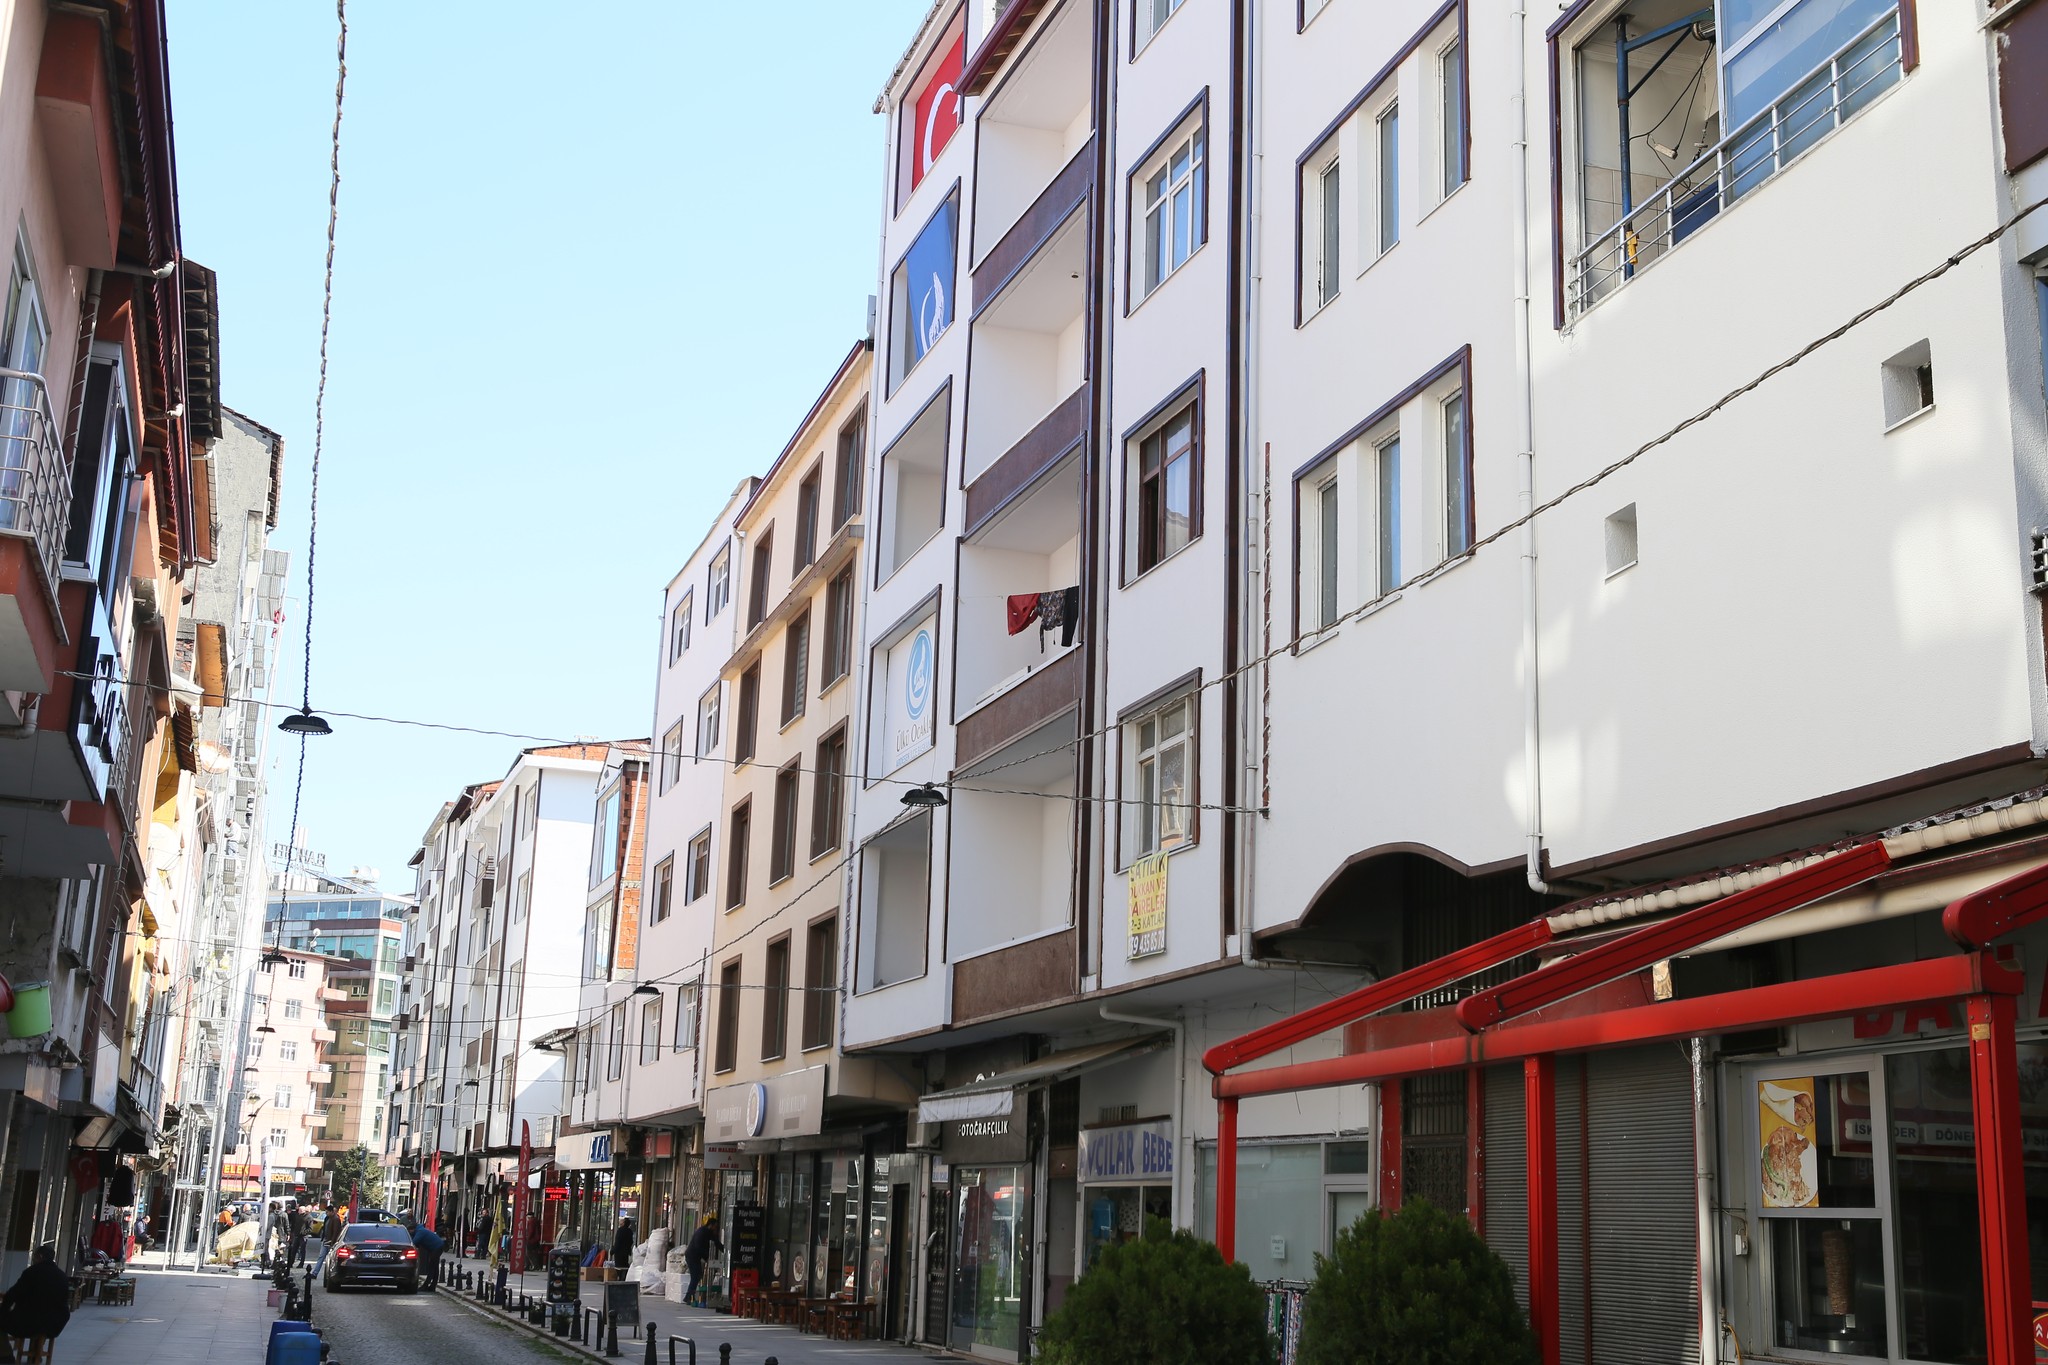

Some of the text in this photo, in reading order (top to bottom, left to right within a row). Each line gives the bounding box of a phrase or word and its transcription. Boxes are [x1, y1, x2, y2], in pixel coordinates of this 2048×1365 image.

[1156, 875, 1165, 891] VE
[958, 1121, 1009, 1138] FOTOĞRAFÇILIK
[1854, 1123, 1916, 1138] İSKDER
[1935, 1129, 1974, 1142] DÖNE
[1142, 1130, 1173, 1173] BEBE
